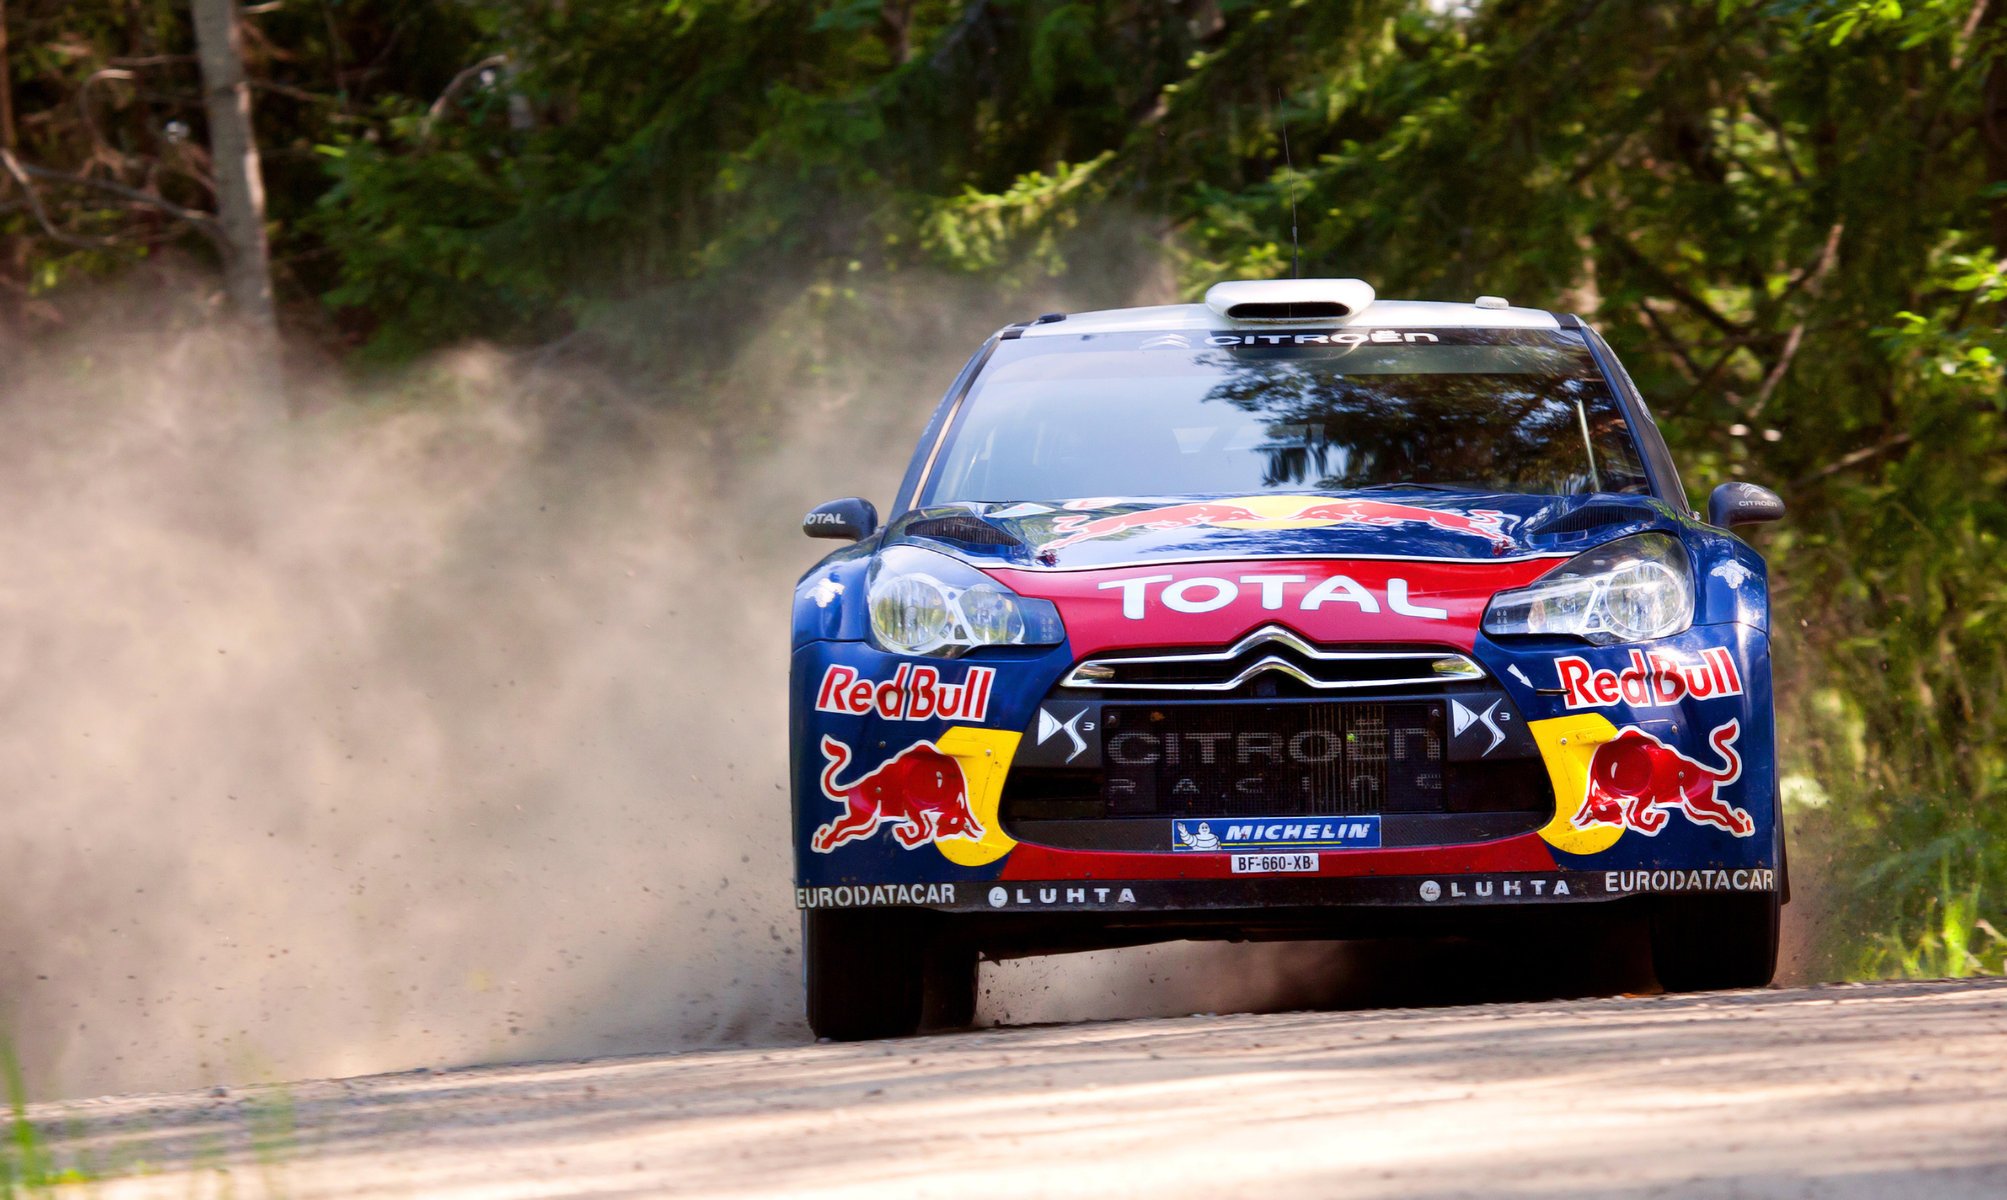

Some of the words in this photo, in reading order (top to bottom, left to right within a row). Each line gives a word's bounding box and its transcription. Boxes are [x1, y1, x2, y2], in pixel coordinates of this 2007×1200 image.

[1098, 574, 1448, 620] TOTAL
[1225, 823, 1371, 840] MICHELIN
[1238, 855, 1311, 871] BF-660-XB
[1450, 879, 1570, 897] LUHTA
[1605, 869, 1774, 892] EURODATACAR
[796, 883, 955, 908] EURODATACAR
[1016, 887, 1136, 904] LUHTA
